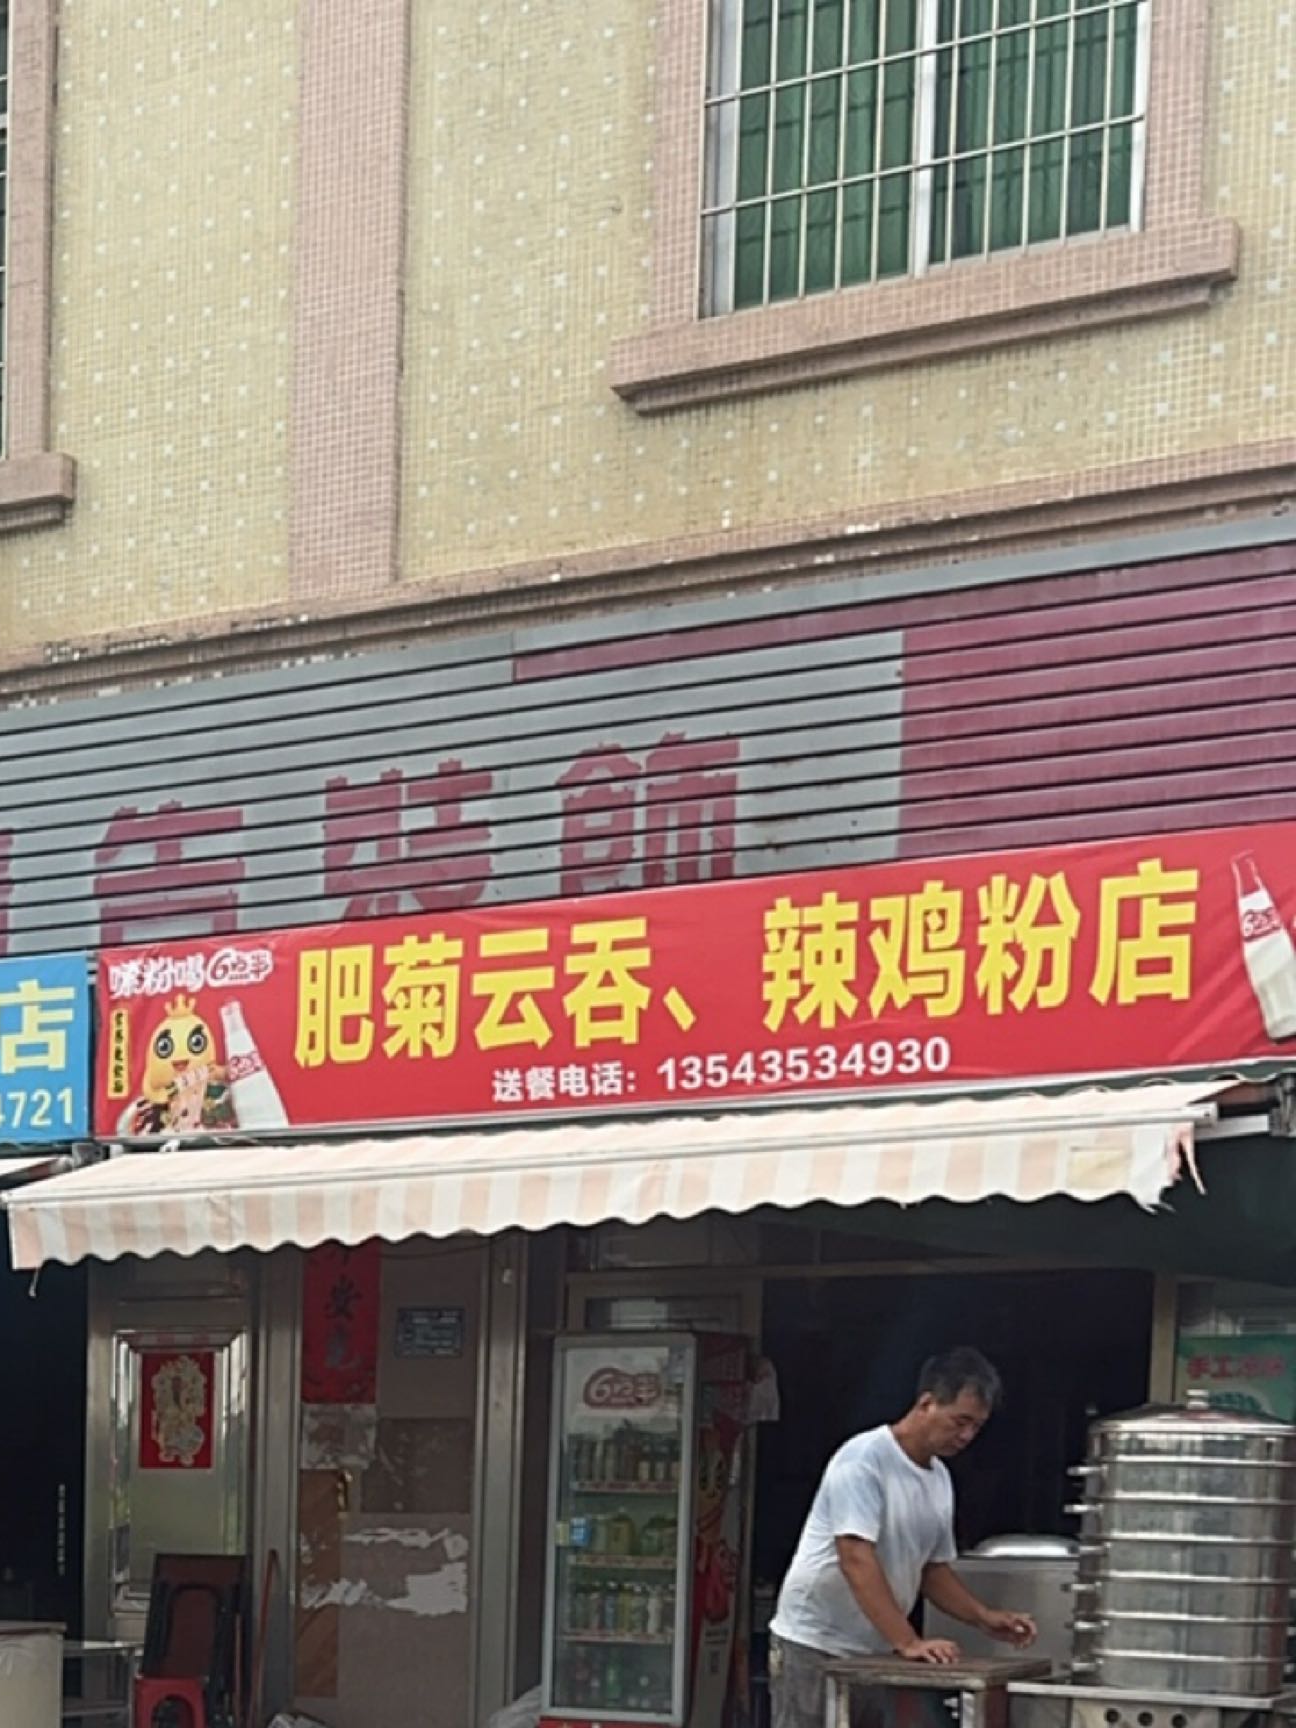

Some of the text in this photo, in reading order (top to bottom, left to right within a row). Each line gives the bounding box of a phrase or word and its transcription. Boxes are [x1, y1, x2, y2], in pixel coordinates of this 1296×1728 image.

[294, 857, 1201, 1070] 肥菊云吞、辣鸡粉店
